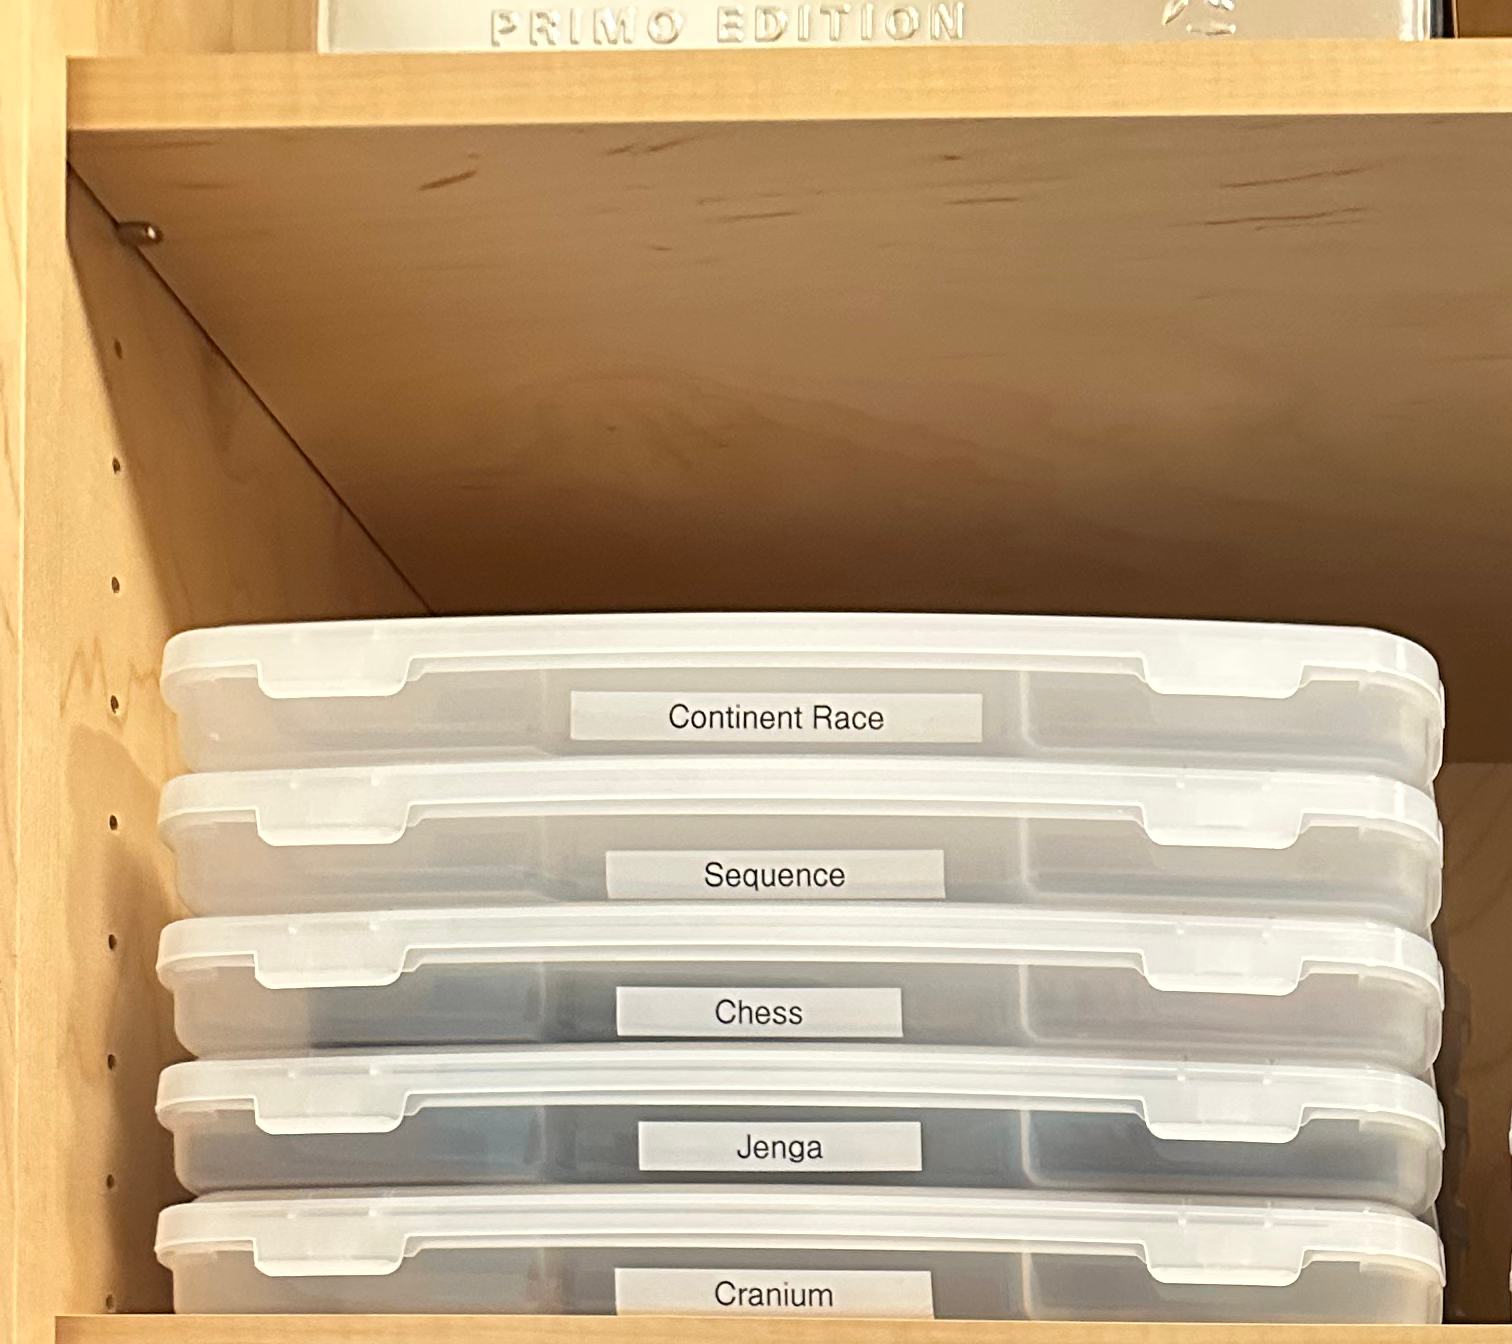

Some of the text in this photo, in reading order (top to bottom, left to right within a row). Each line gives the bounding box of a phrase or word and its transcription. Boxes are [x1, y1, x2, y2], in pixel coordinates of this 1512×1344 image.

[490, 2, 966, 46] PRIMO EDITION
[668, 702, 885, 731] Continent Race
[703, 860, 846, 892] Sequence
[714, 997, 804, 1026] Chess
[735, 1133, 824, 1165] Jenga
[714, 1280, 834, 1308] Cranium
